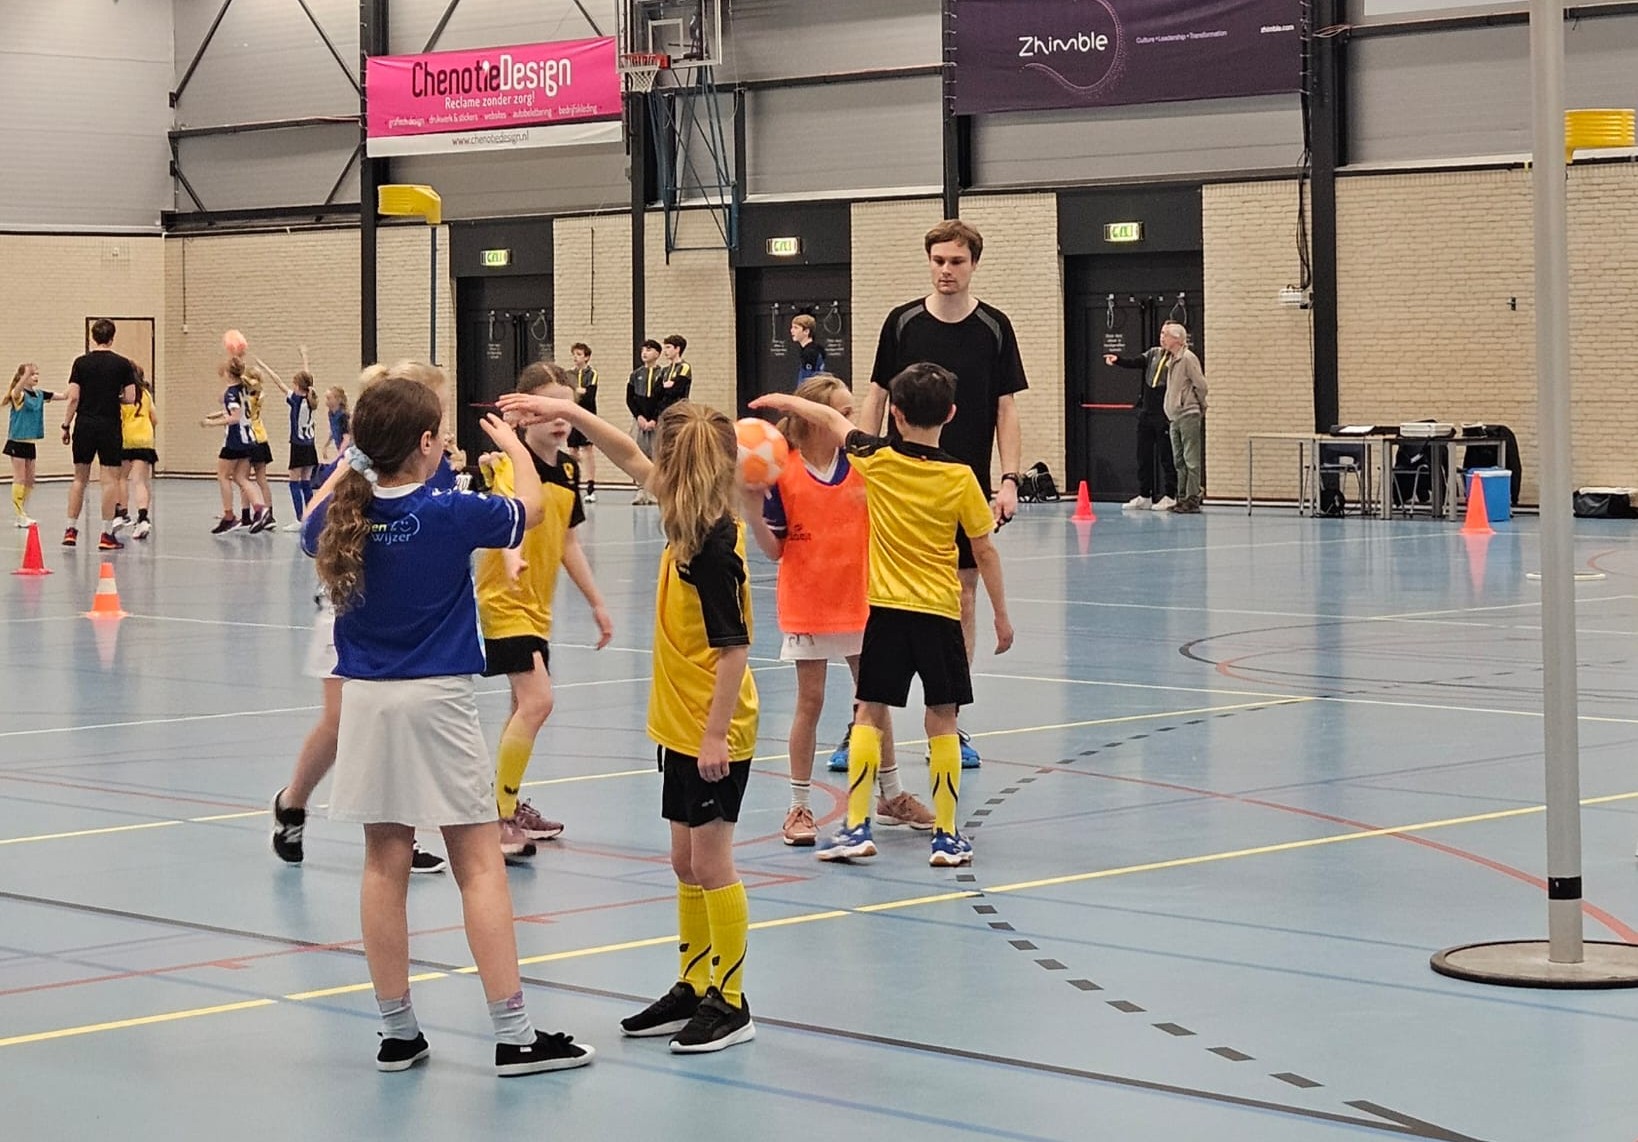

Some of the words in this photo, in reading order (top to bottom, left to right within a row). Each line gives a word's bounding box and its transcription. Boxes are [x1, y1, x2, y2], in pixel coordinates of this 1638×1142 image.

[1019, 31, 1108, 57] Zhimble
[412, 55, 571, 97] ChenotieDesign
[445, 97, 480, 110] Reclame
[482, 94, 511, 107] zonder
[513, 92, 536, 107] zorg!
